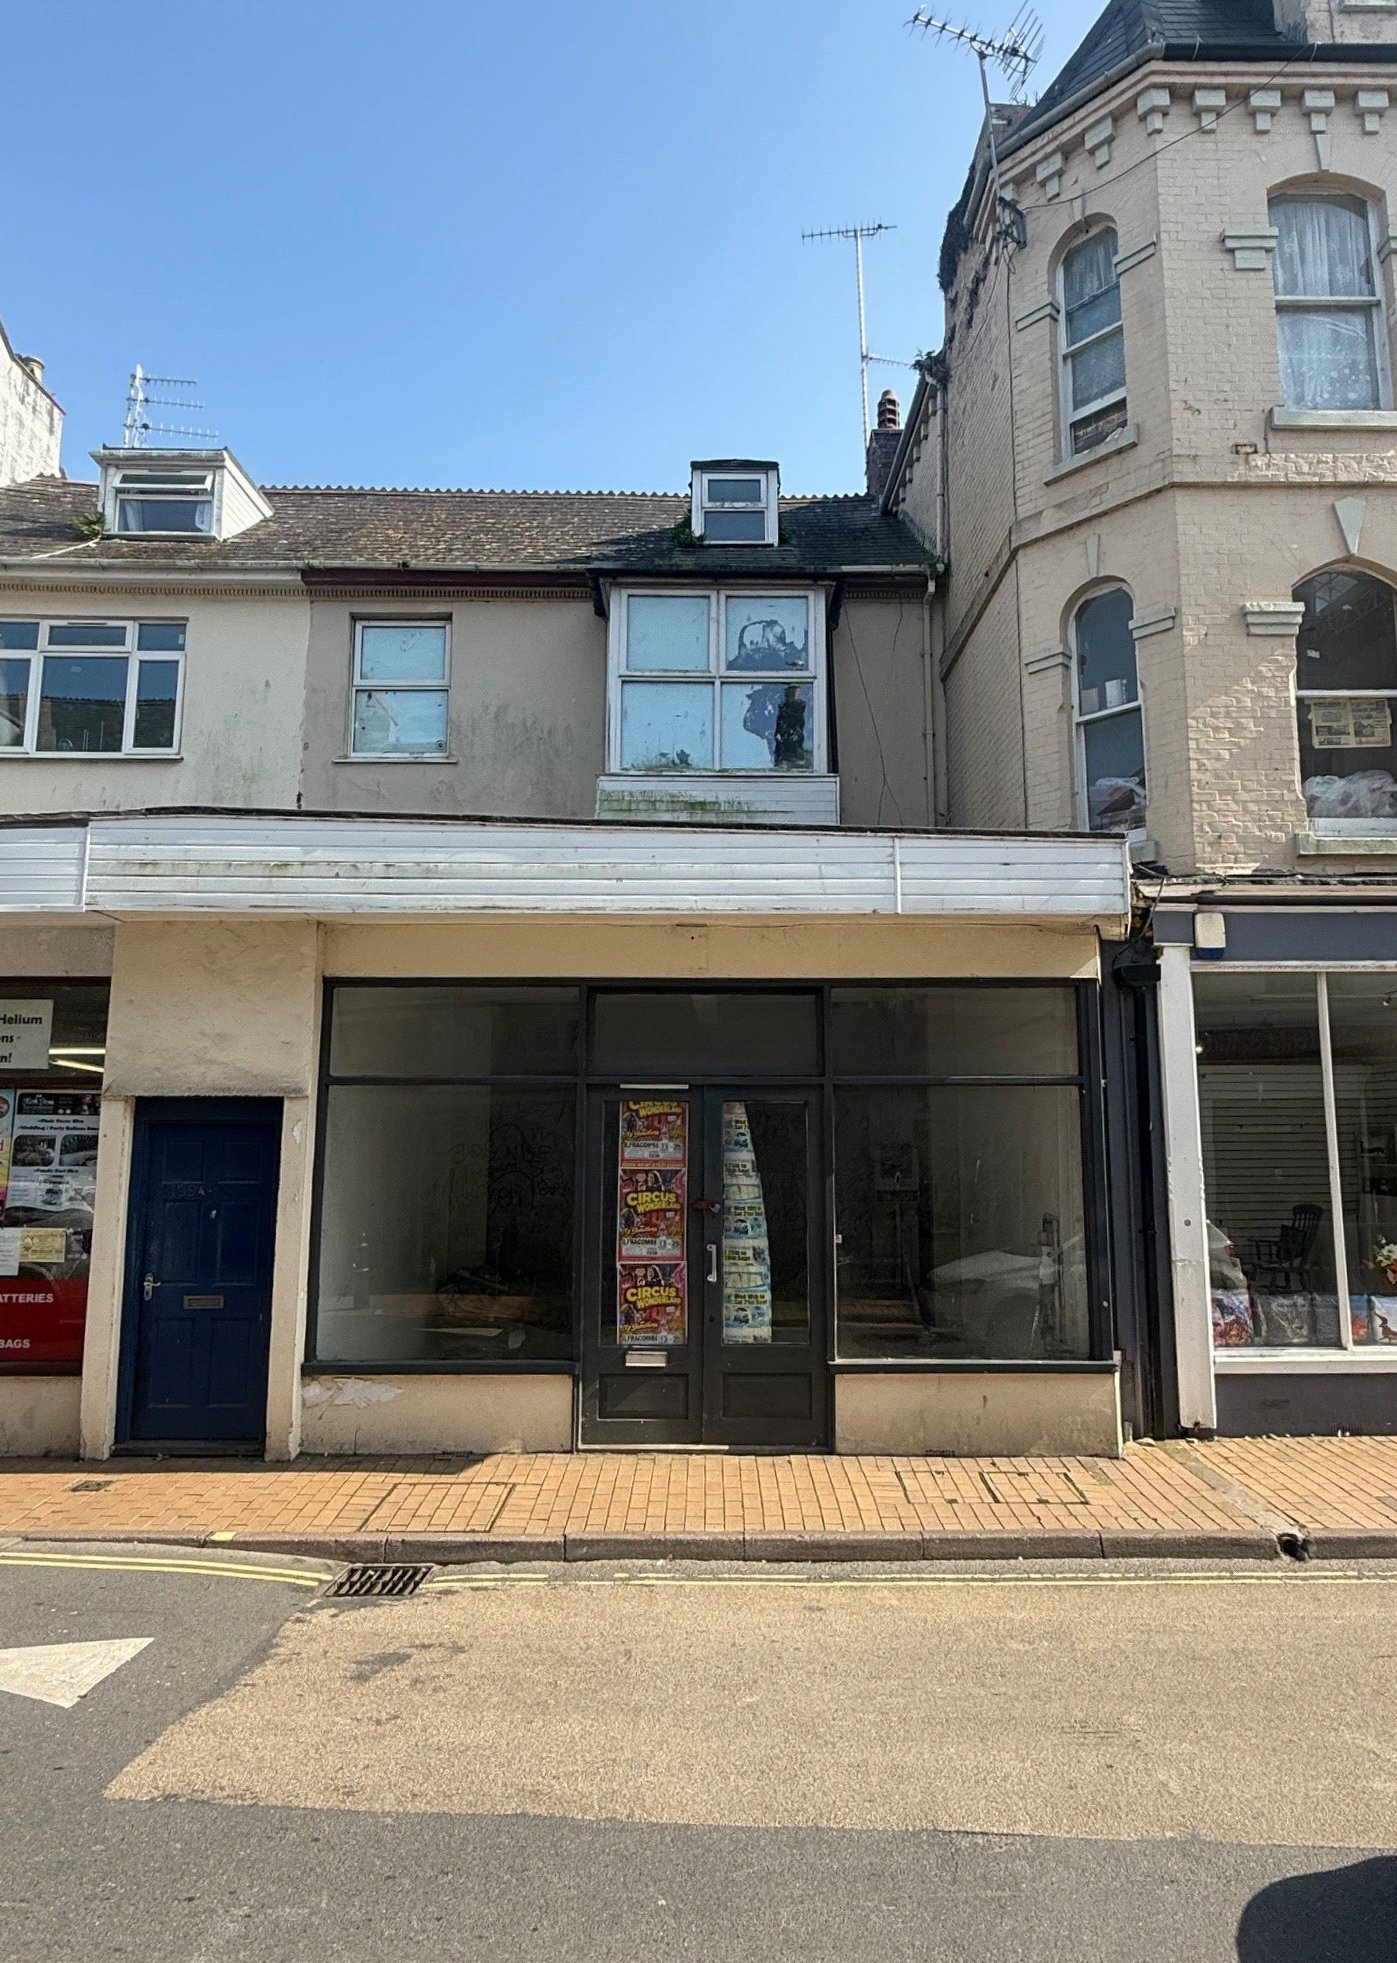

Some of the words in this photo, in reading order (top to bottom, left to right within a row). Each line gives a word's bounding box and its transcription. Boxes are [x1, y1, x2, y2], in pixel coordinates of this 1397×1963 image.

[0, 1035, 14, 1043] ns
[626, 1191, 677, 1206] CIRCUS
[626, 1287, 677, 1302] CIRCUS
